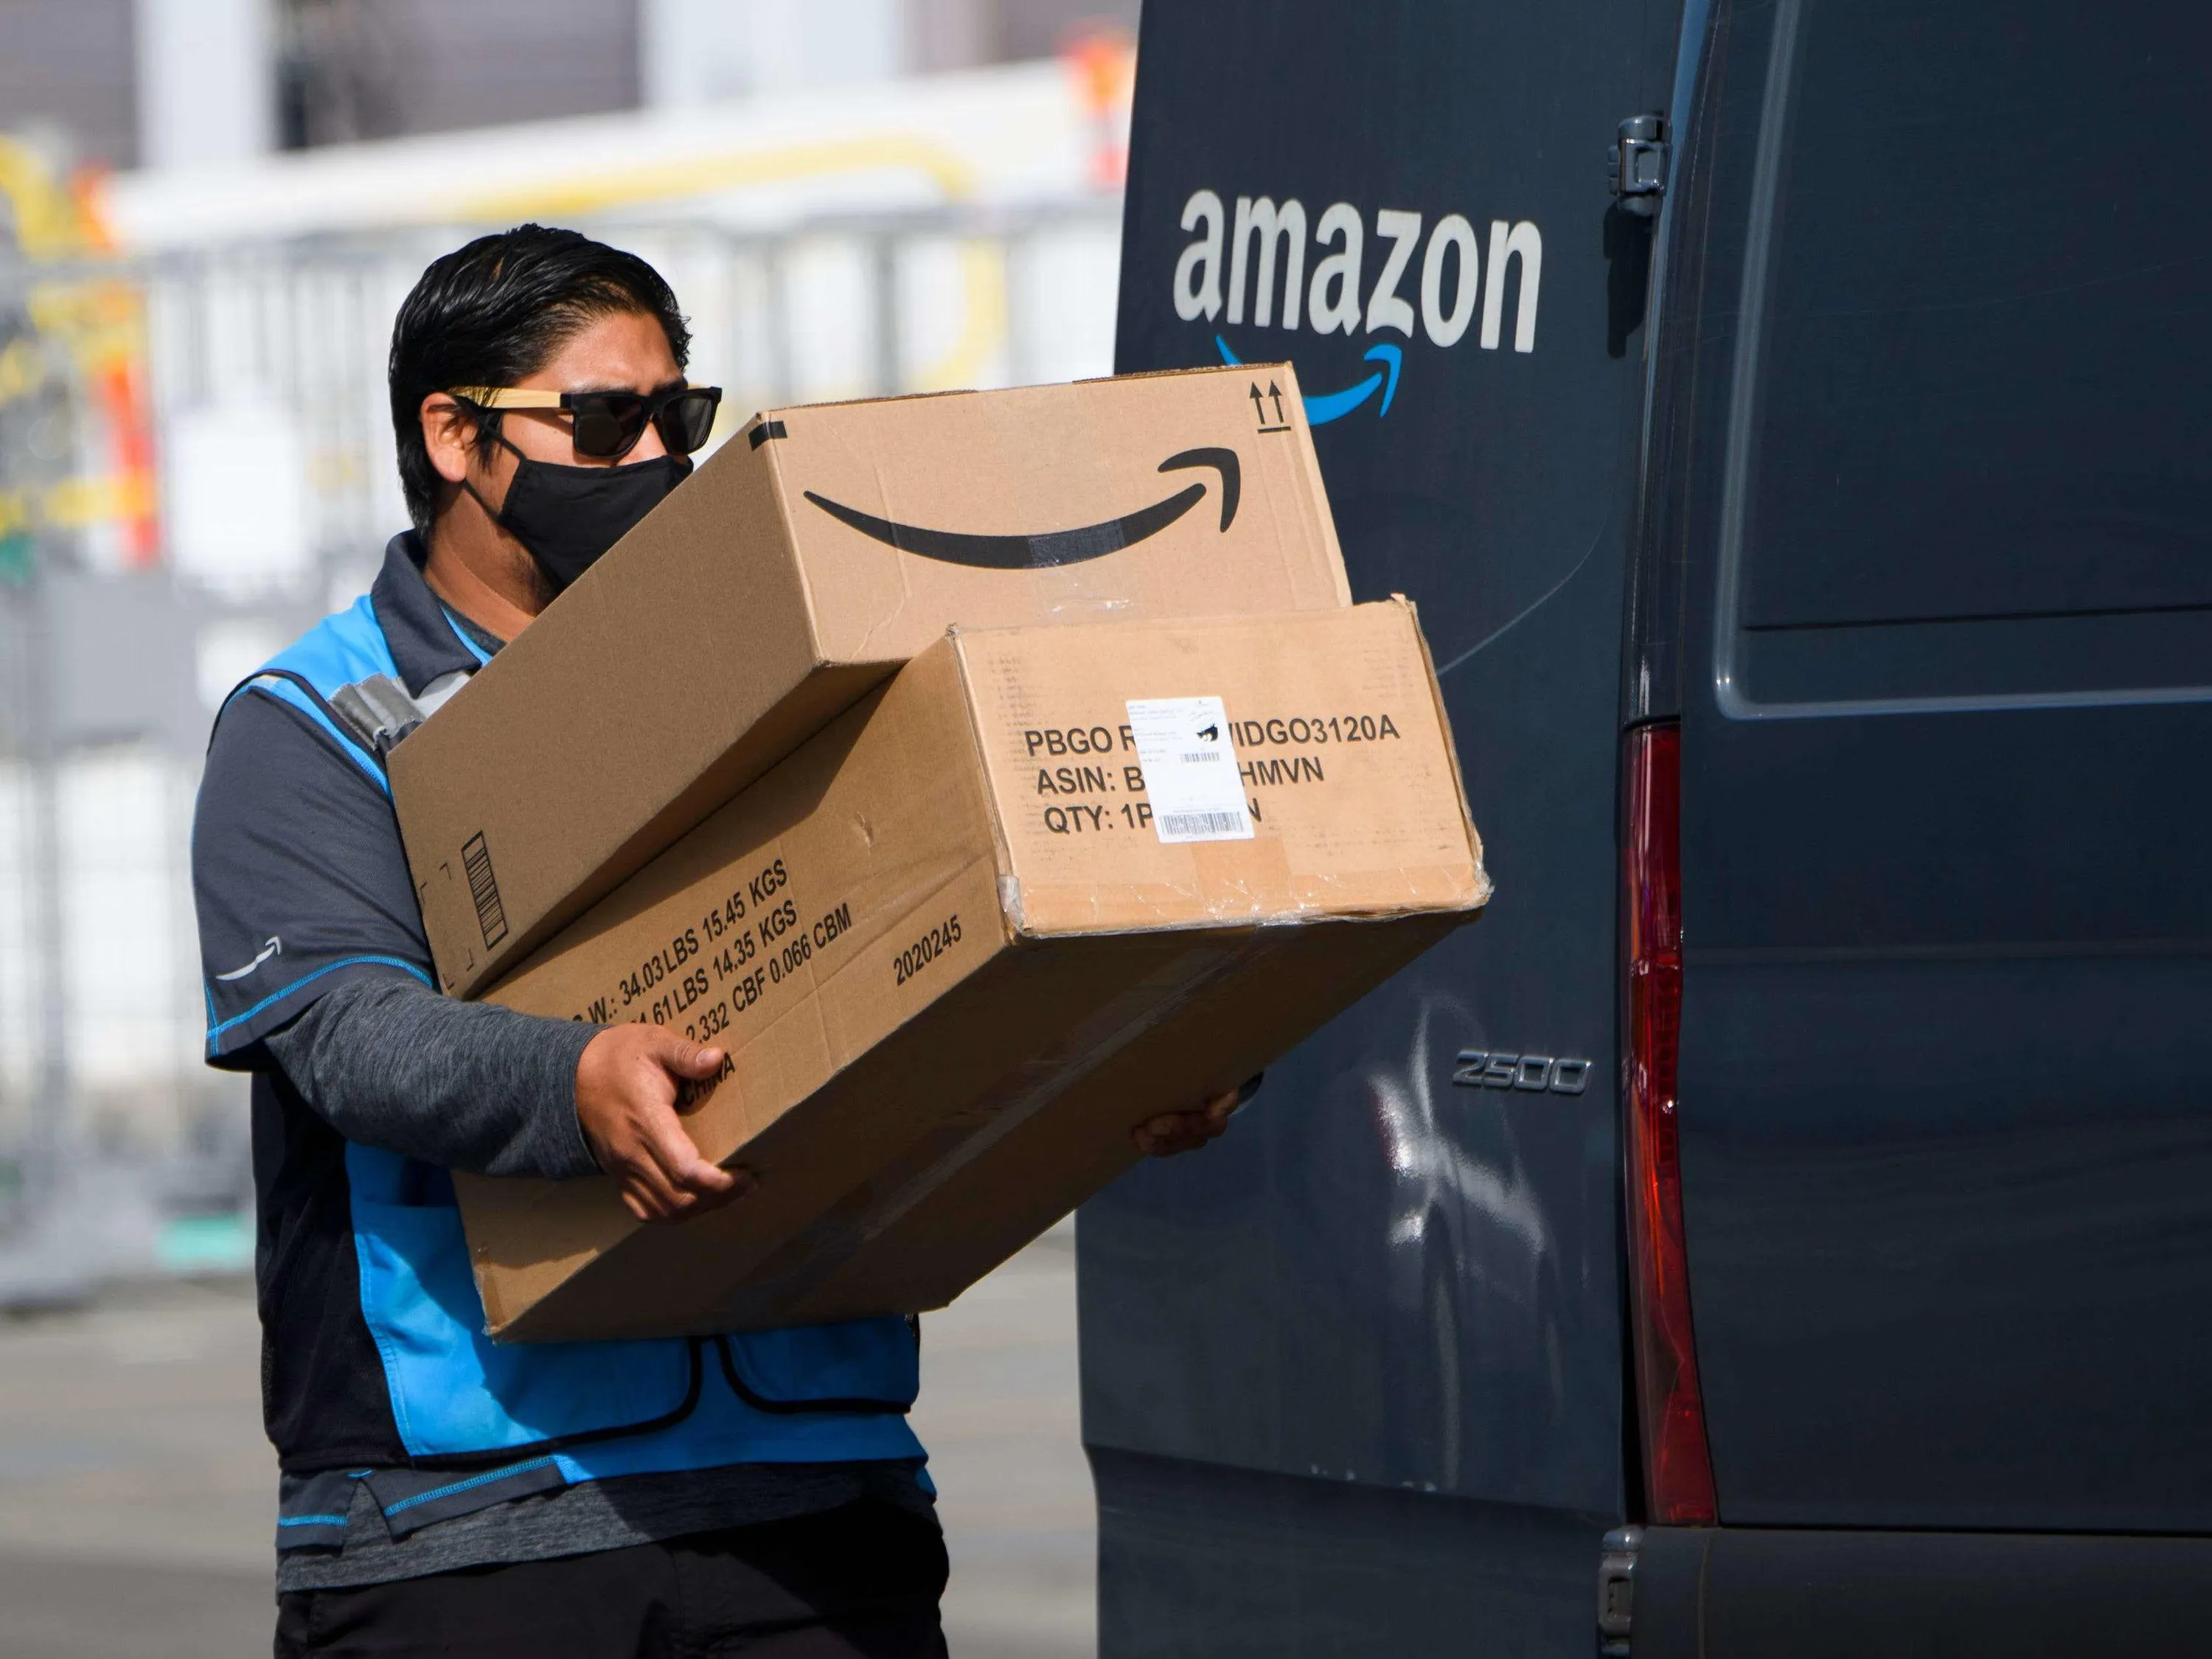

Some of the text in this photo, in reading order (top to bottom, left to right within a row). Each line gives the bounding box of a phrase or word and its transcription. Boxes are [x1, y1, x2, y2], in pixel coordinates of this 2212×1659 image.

[1173, 189, 1543, 353] amazon
[1024, 726, 1113, 757] PBGO
[1228, 714, 1401, 748] IDGO3120A
[1037, 766, 1116, 795] ASIN:
[1044, 804, 1114, 835] QTY:
[702, 891, 745, 943] 15.45
[748, 858, 787, 908] KGS
[713, 931, 755, 981] 14.35
[759, 899, 797, 948] KGS
[732, 967, 765, 1012] CBF
[769, 933, 812, 984] 0.066
[813, 902, 852, 949] CBM
[893, 914, 962, 987] 2020245
[1451, 1049, 1593, 1094] 2500
